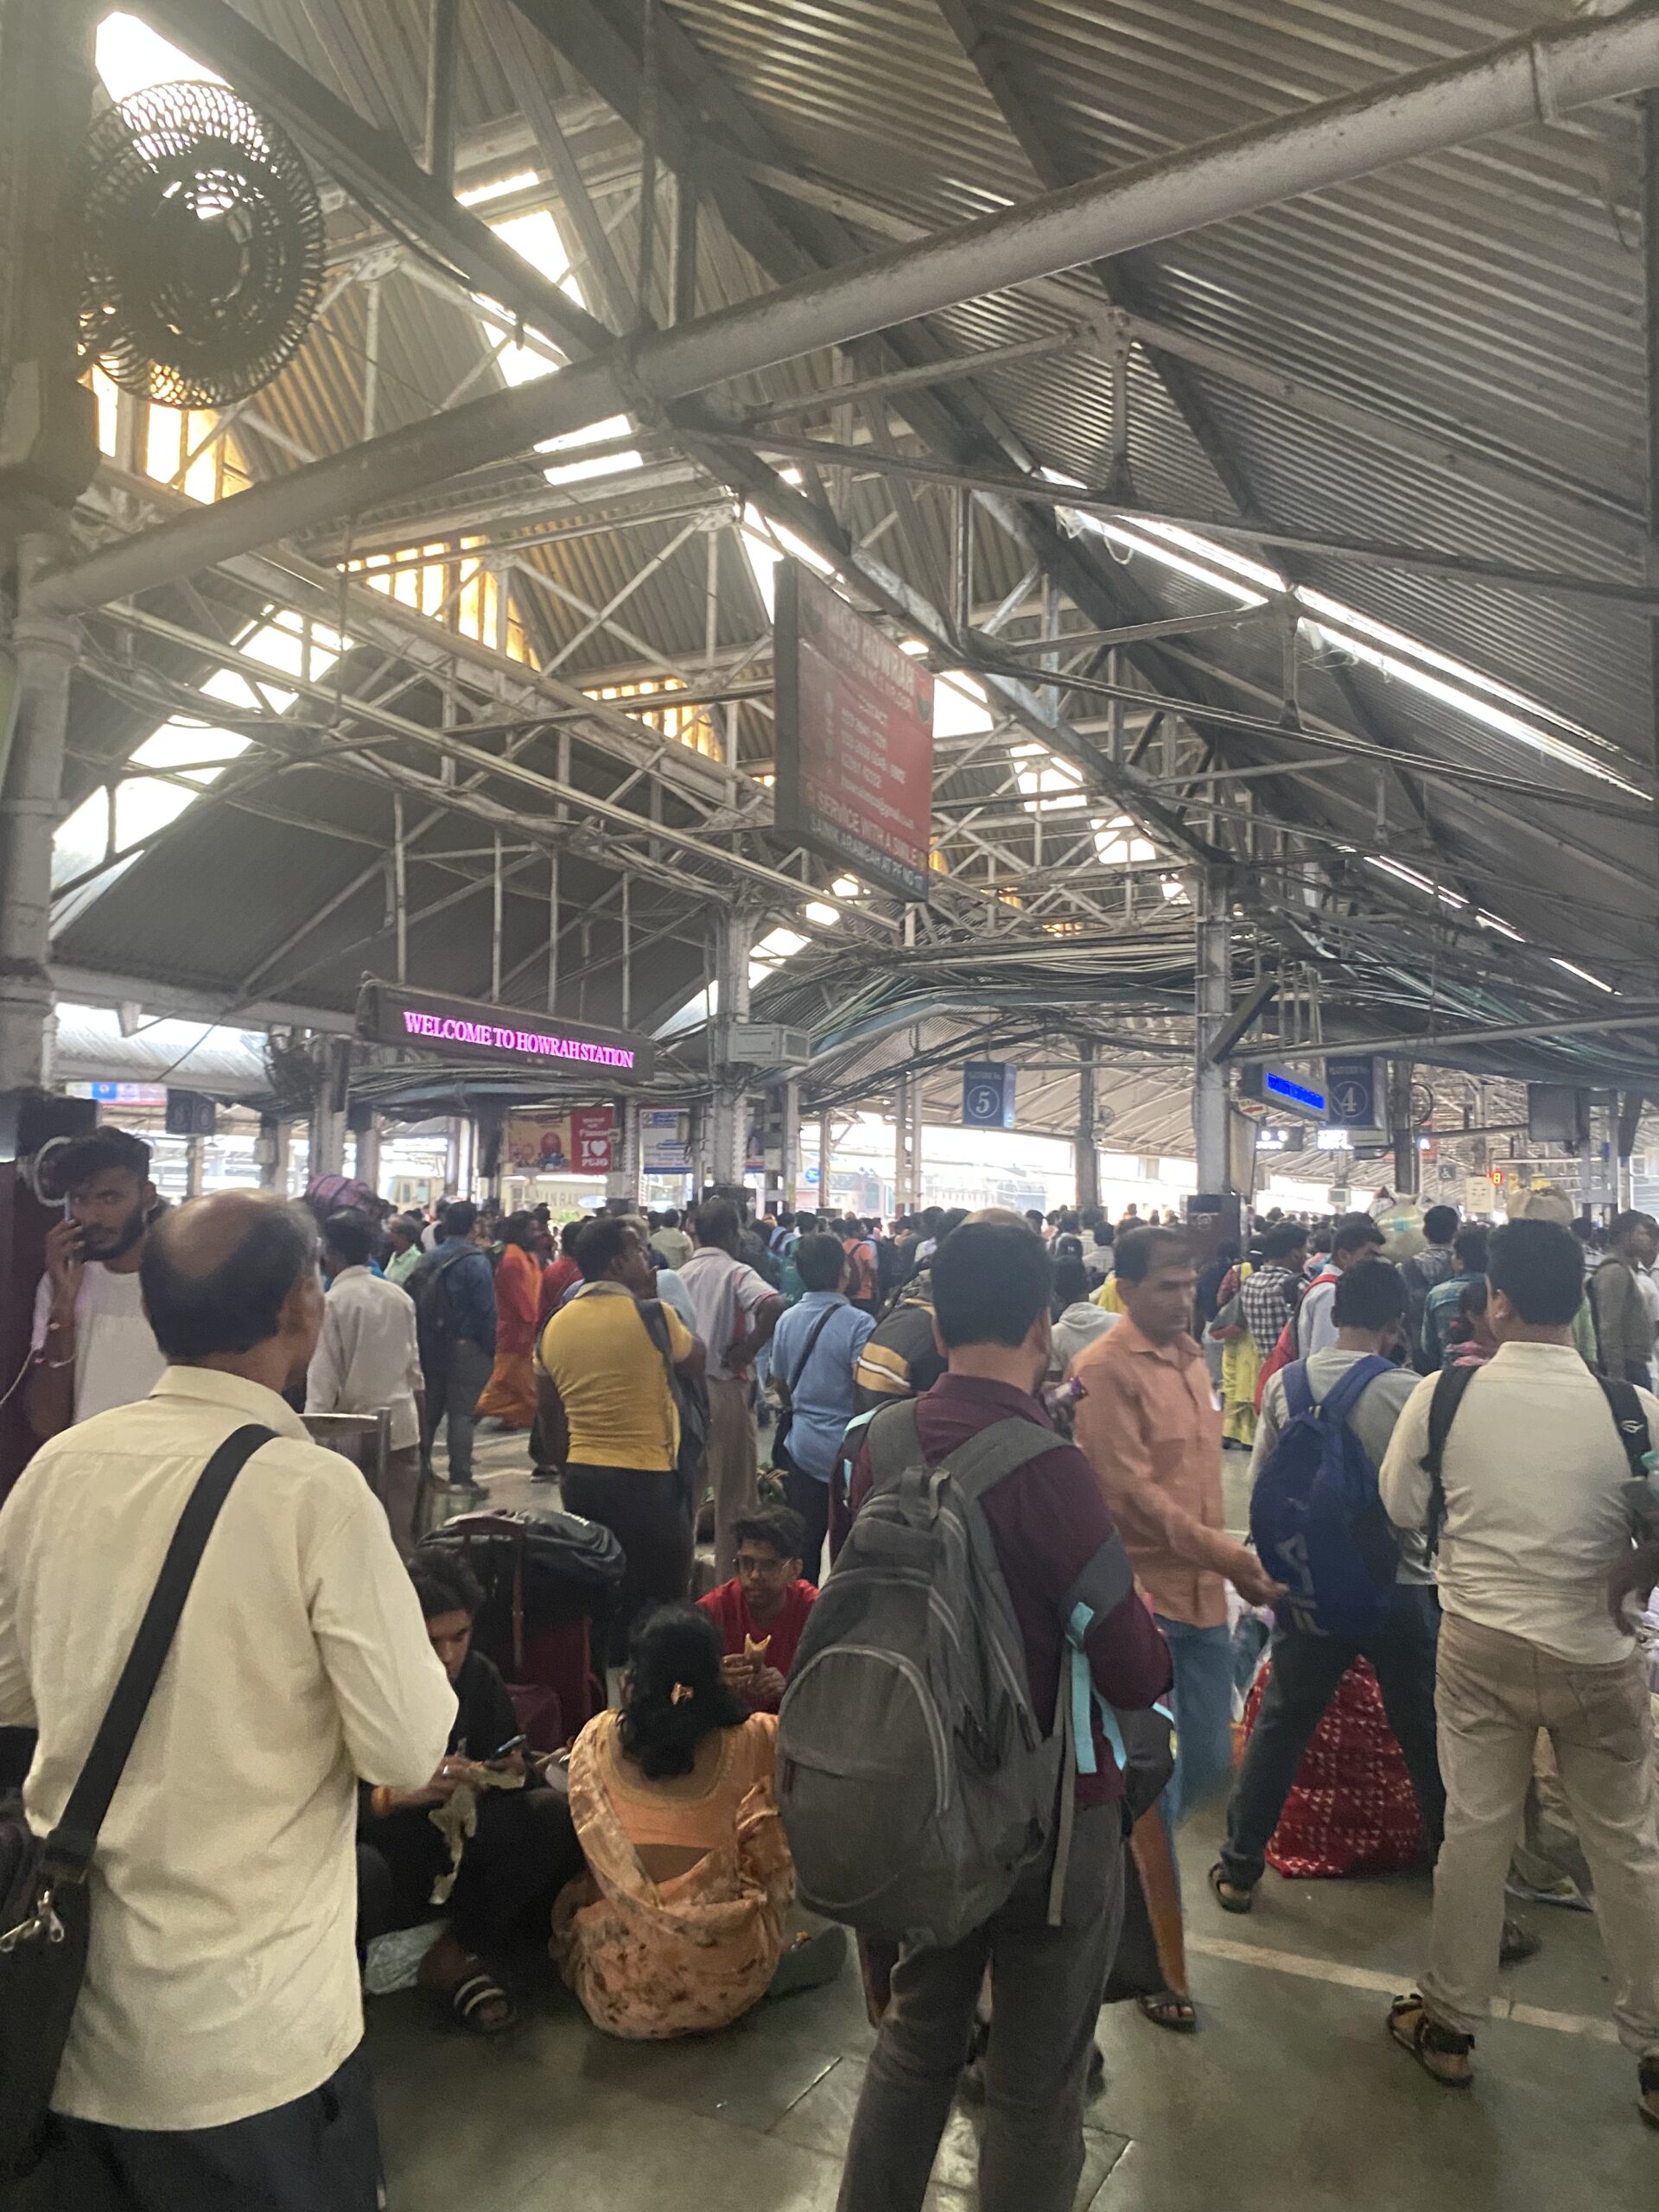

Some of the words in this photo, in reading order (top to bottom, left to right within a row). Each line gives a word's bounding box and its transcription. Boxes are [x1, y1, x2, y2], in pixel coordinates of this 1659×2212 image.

[862, 621, 914, 696] HOWRAH
[817, 791, 859, 835] SERVICE
[861, 817, 884, 847] WITH
[887, 831, 891, 848] A
[893, 836, 917, 866] SMILE
[881, 855, 893, 874] AT
[404, 1011, 492, 1046] WELCOME
[493, 1027, 517, 1049] TO
[517, 1031, 580, 1061] HOWRAH
[581, 1043, 634, 1069] STATION
[976, 1090, 991, 1114] 5
[1341, 1087, 1357, 1112] 4
[581, 1141, 590, 1157] I
